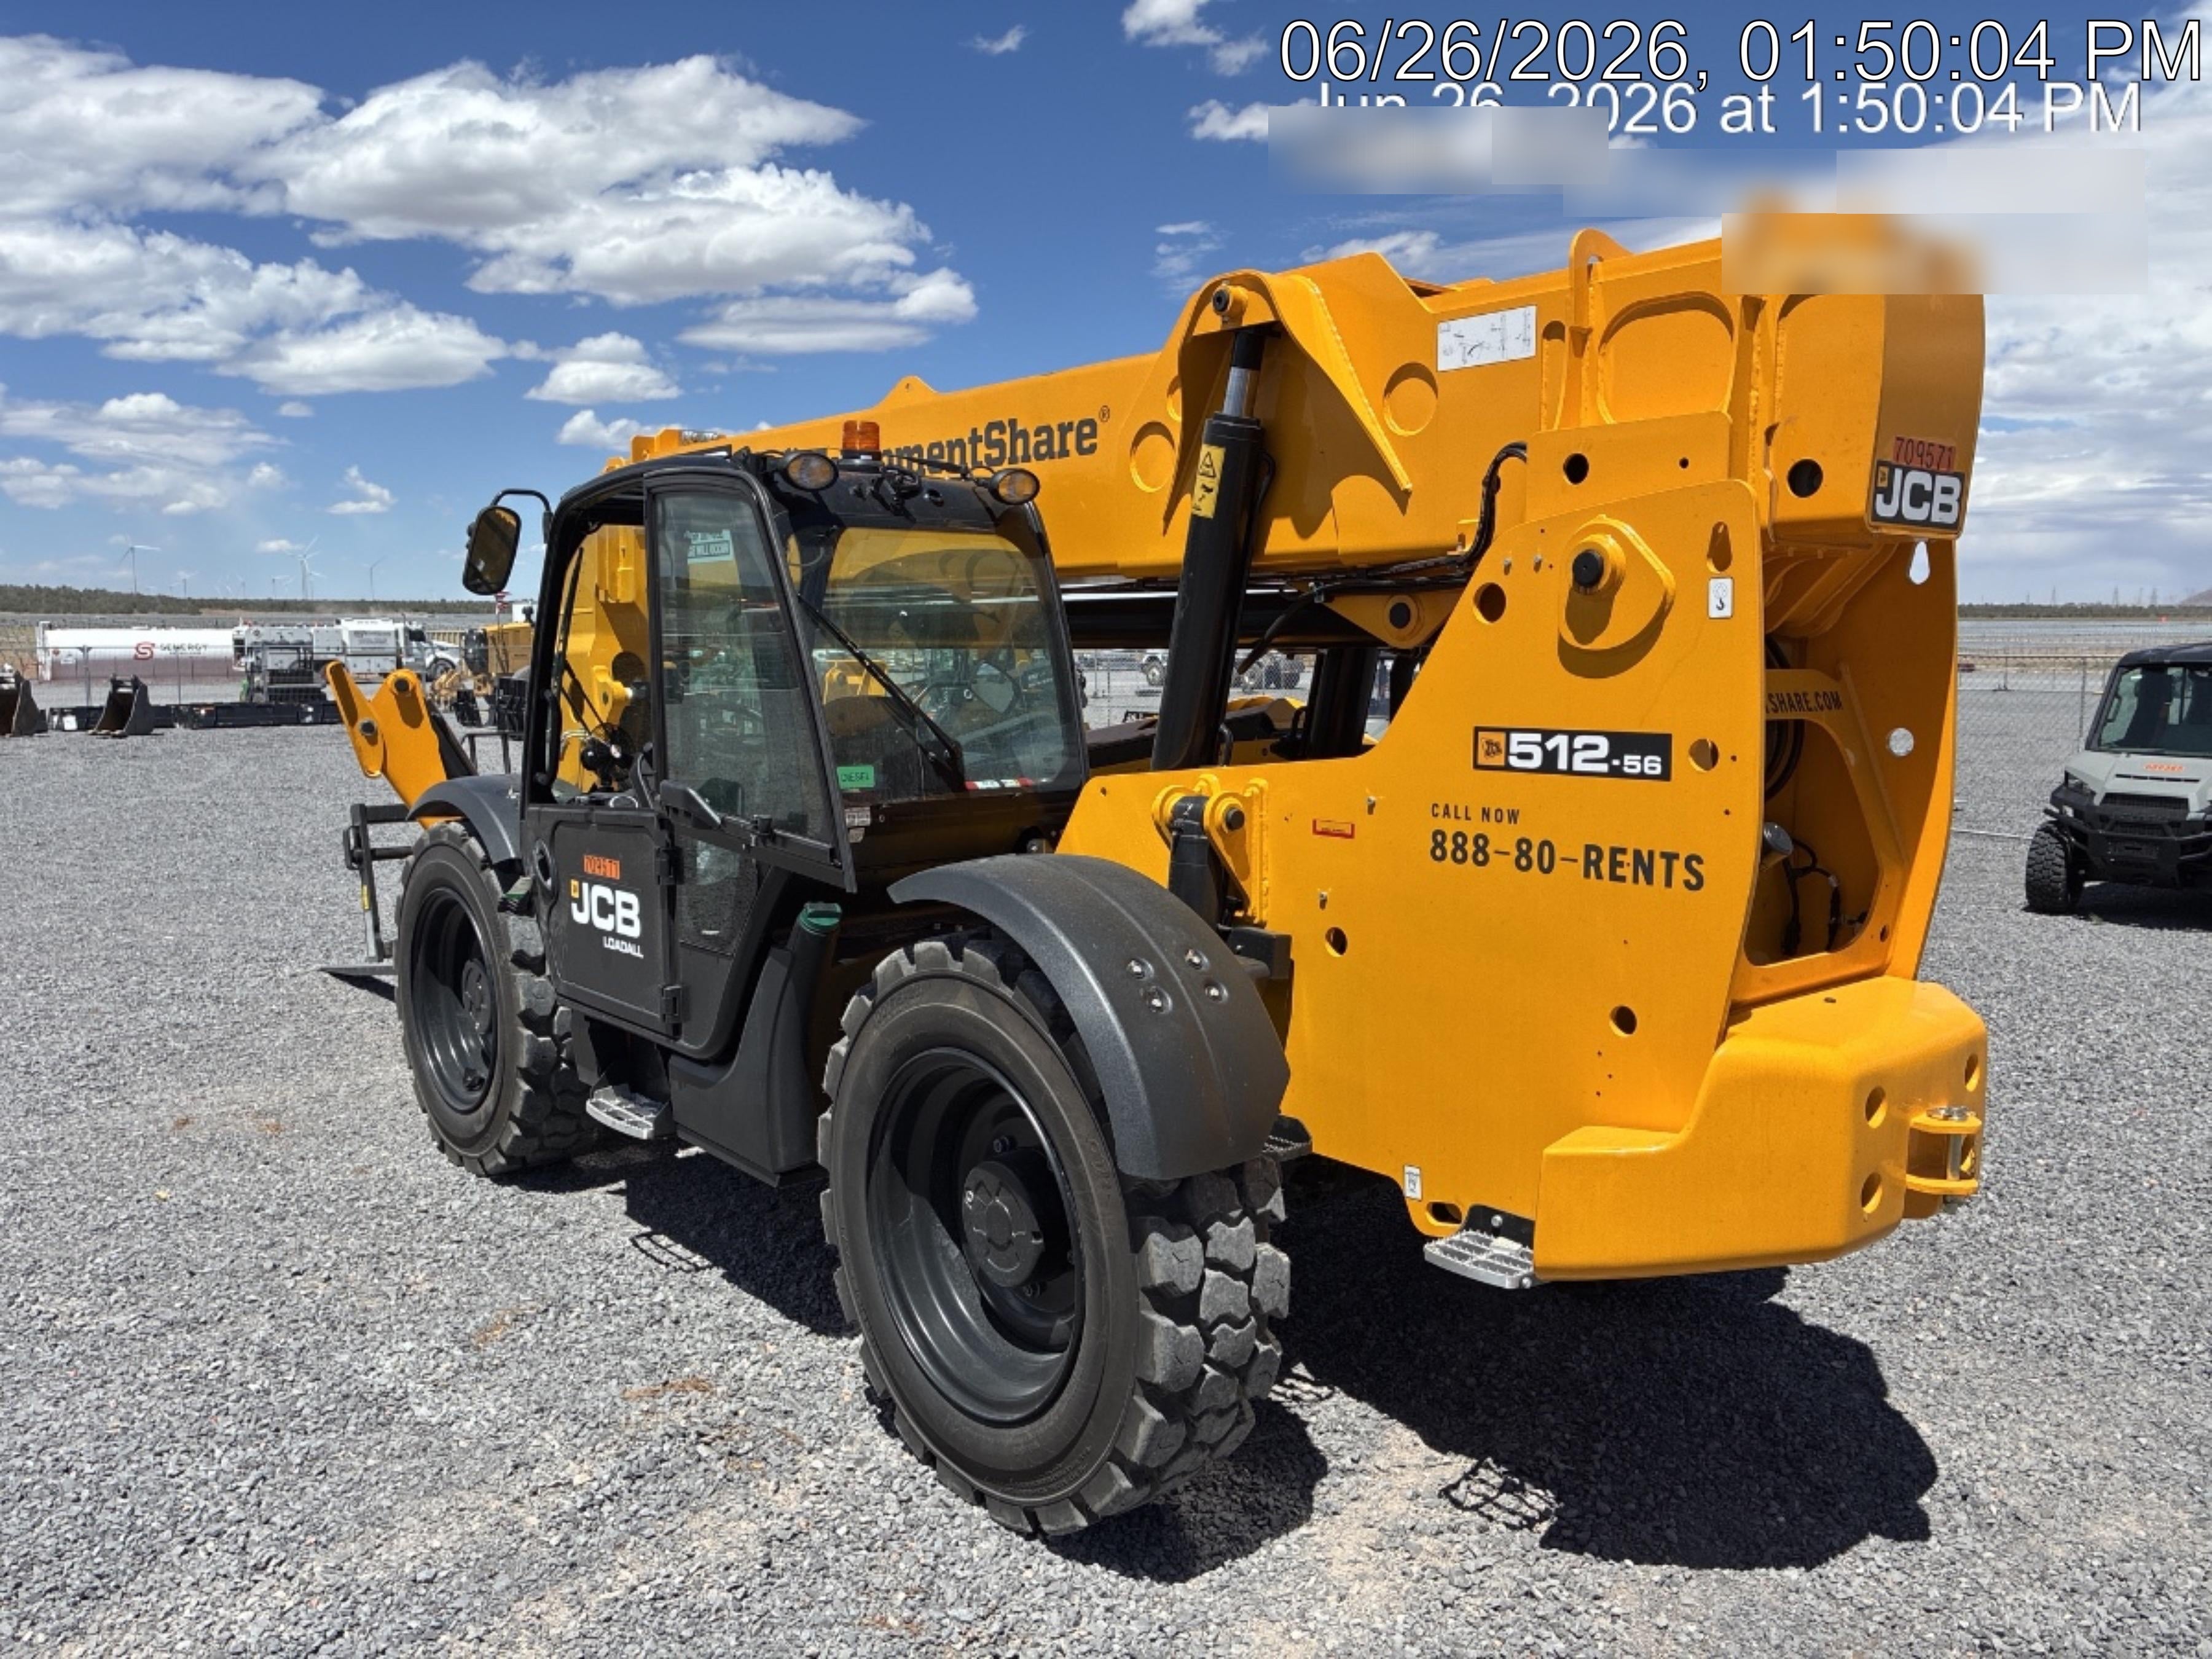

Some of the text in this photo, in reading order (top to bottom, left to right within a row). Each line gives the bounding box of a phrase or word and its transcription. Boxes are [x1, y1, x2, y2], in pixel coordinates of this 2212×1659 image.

[1895, 436, 1954, 471] 709571
[1875, 468, 1962, 525] JCB
[1766, 691, 1843, 713] SHARE.COM
[1431, 802, 1520, 825] CALL NOW
[1429, 828, 1705, 892] 888-80-RENTS
[571, 882, 641, 939] JCB
[602, 935, 645, 959] LOADALL
